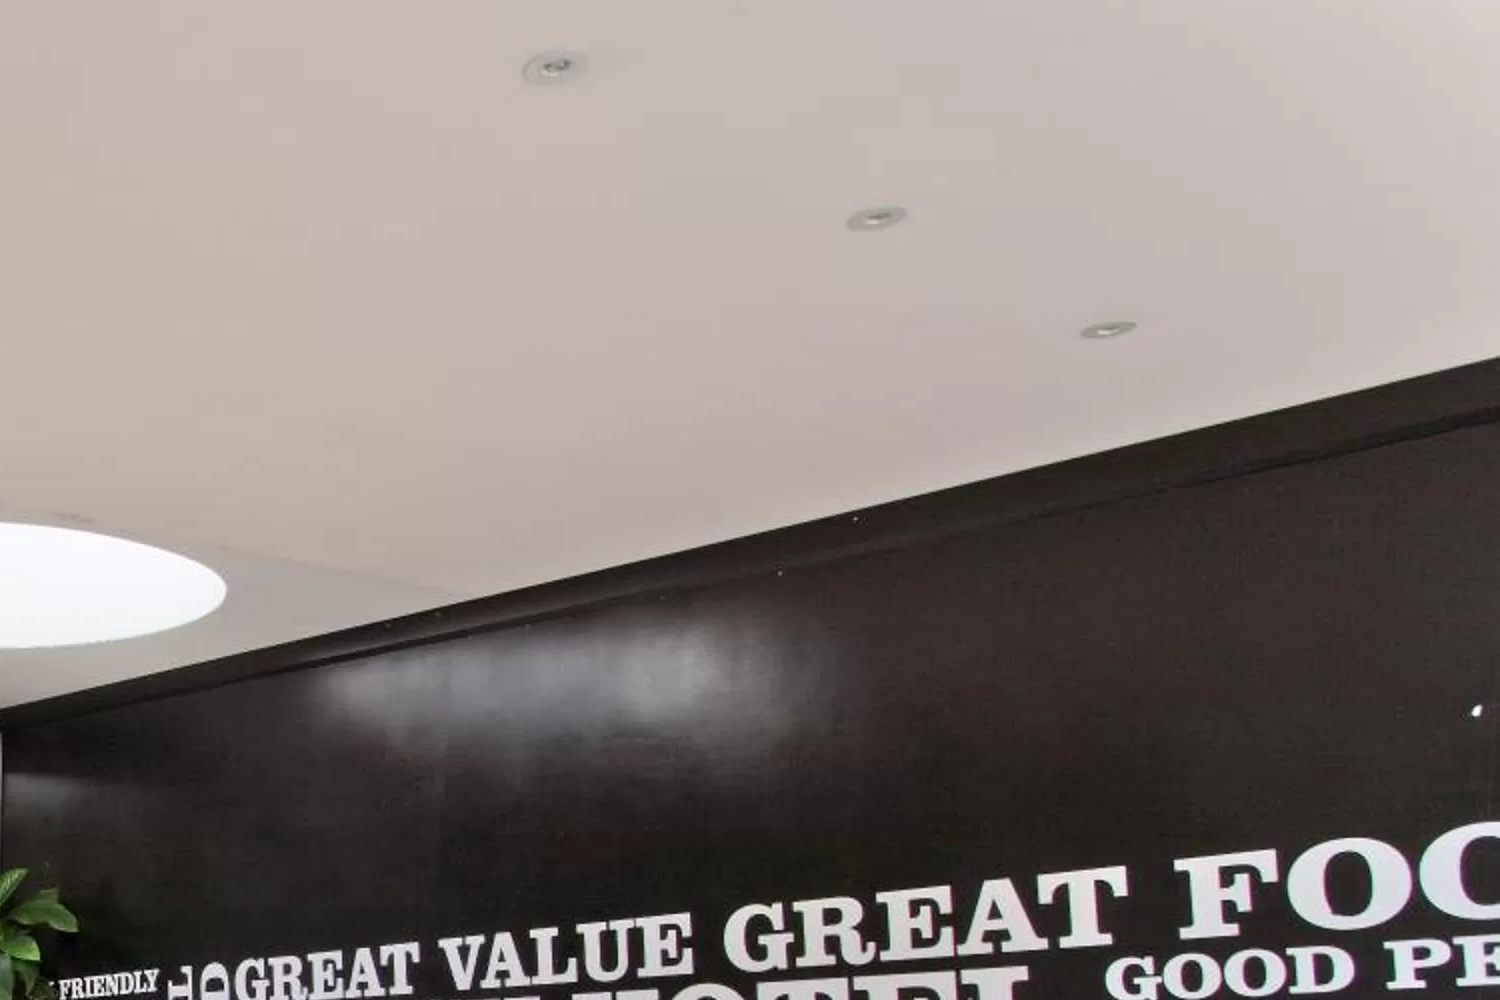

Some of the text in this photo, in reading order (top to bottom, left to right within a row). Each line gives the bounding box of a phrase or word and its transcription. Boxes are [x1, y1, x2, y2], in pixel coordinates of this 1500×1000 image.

[438, 911, 695, 992] VALUE
[723, 865, 1129, 973] GREAT
[59, 967, 161, 1000] FRIENDLY
